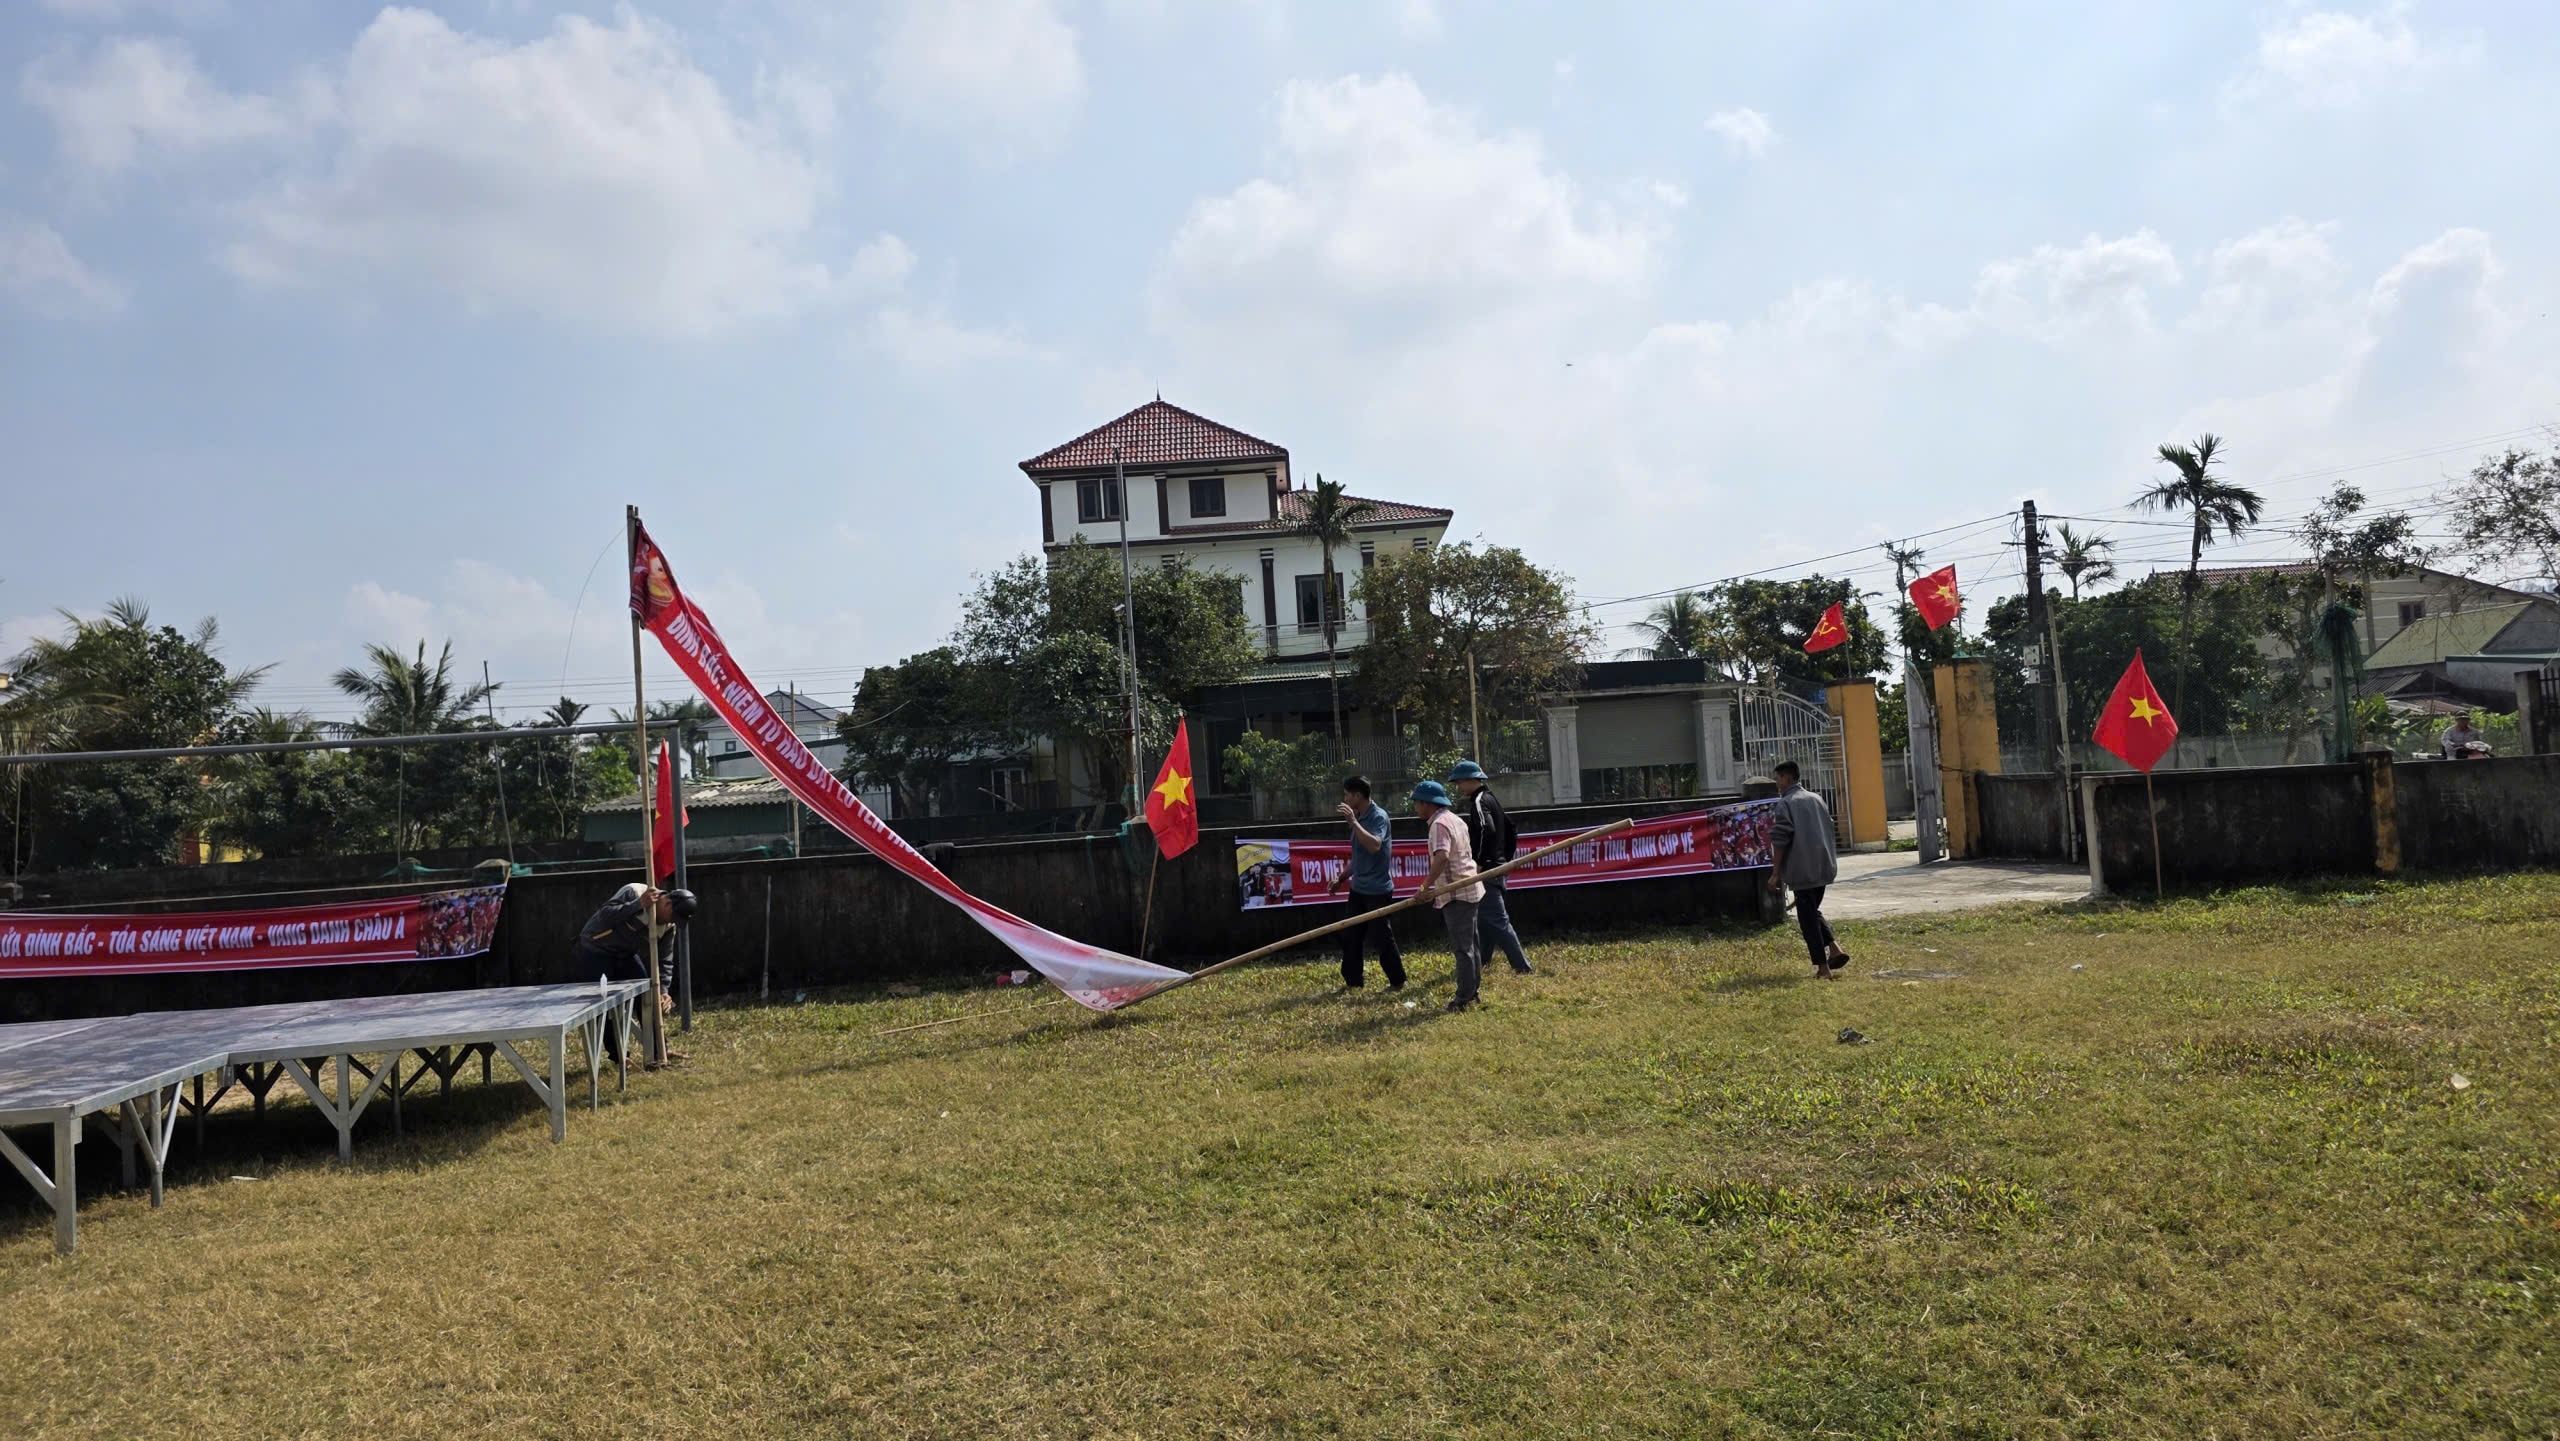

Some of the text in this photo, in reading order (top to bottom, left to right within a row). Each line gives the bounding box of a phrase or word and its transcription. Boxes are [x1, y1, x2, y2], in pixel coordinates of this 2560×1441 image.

[1301, 859, 1321, 884] U23
[1631, 835, 1657, 859] RINH
[1657, 829, 1679, 857] CÚP
[64, 924, 96, 956] BẮC
[139, 926, 182, 953] SÁNG
[185, 924, 218, 956] VIỆT
[218, 925, 255, 949] NAM
[267, 922, 306, 946] VANG
[309, 919, 349, 945] DANH
[353, 912, 392, 943] CHÂU
